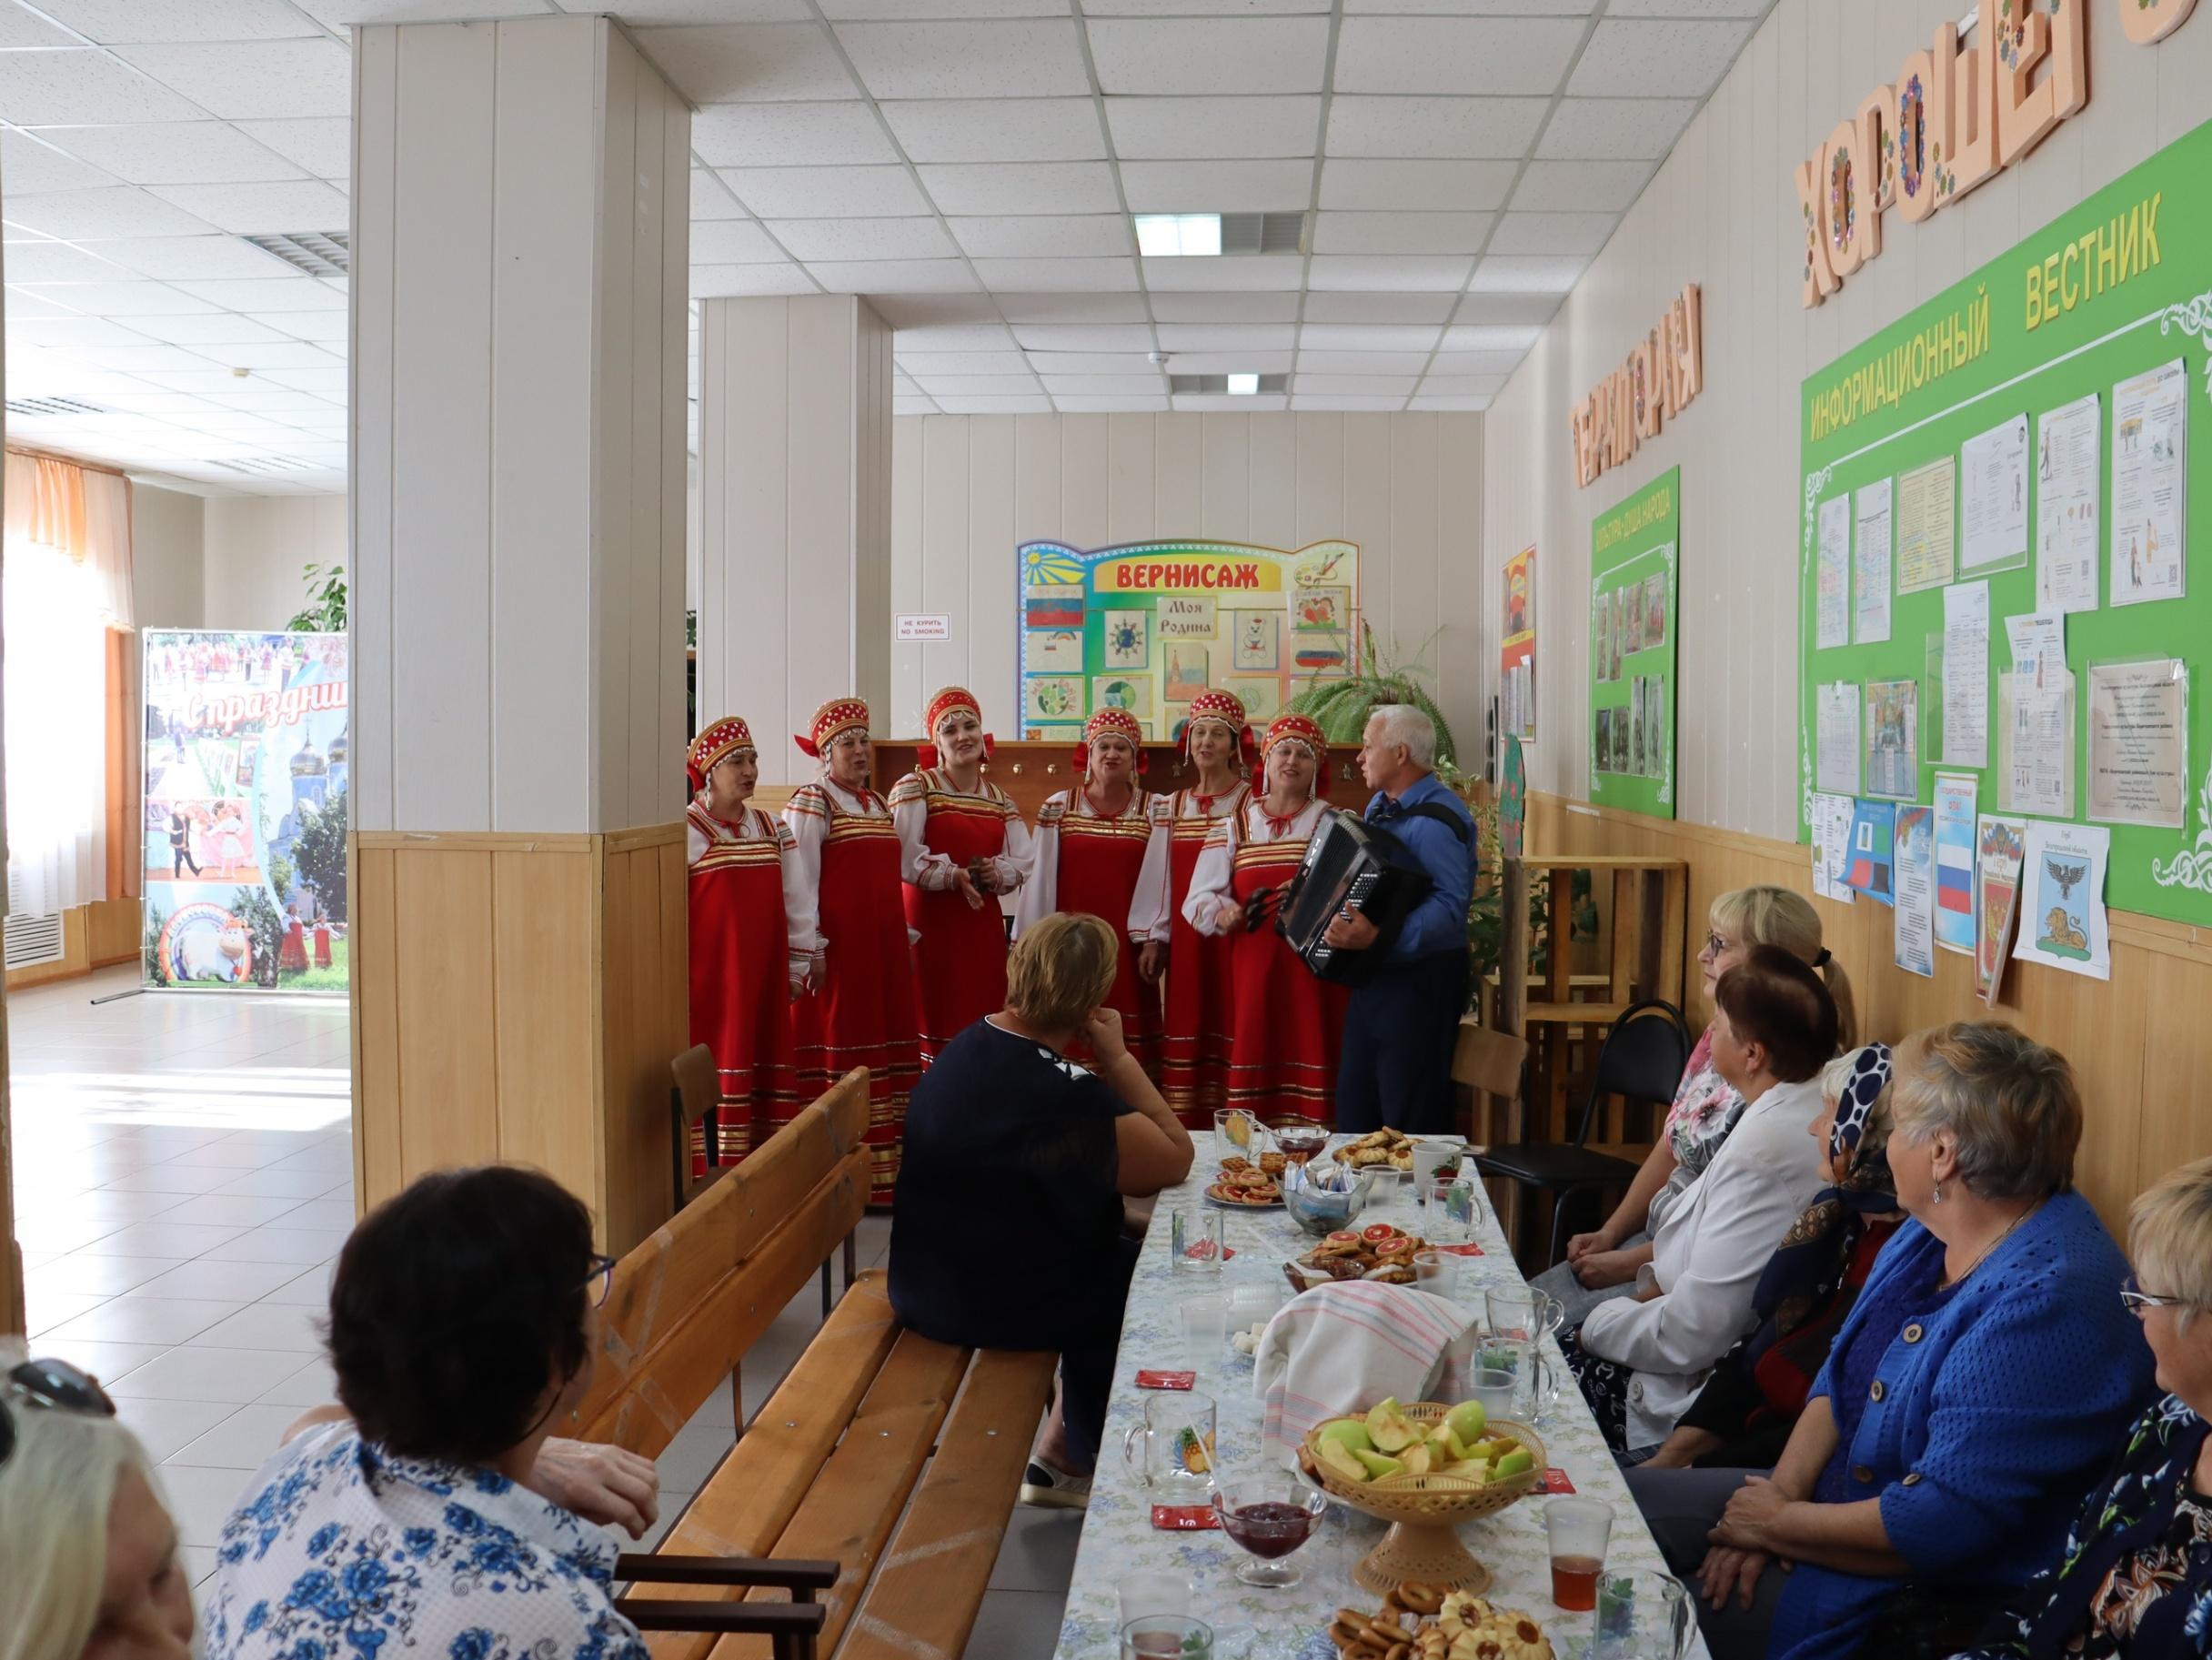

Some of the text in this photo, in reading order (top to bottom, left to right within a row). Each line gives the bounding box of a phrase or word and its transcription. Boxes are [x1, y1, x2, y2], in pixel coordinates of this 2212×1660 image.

[1811, 281, 1990, 442] ИНФОРМАЦИОННЫЙ
[2026, 191, 2162, 332] ВЕСТНИК
[1117, 563, 1260, 589] ВЕРНИСАЖ
[1169, 600, 1202, 613] Моя
[1161, 619, 1211, 634] Родина
